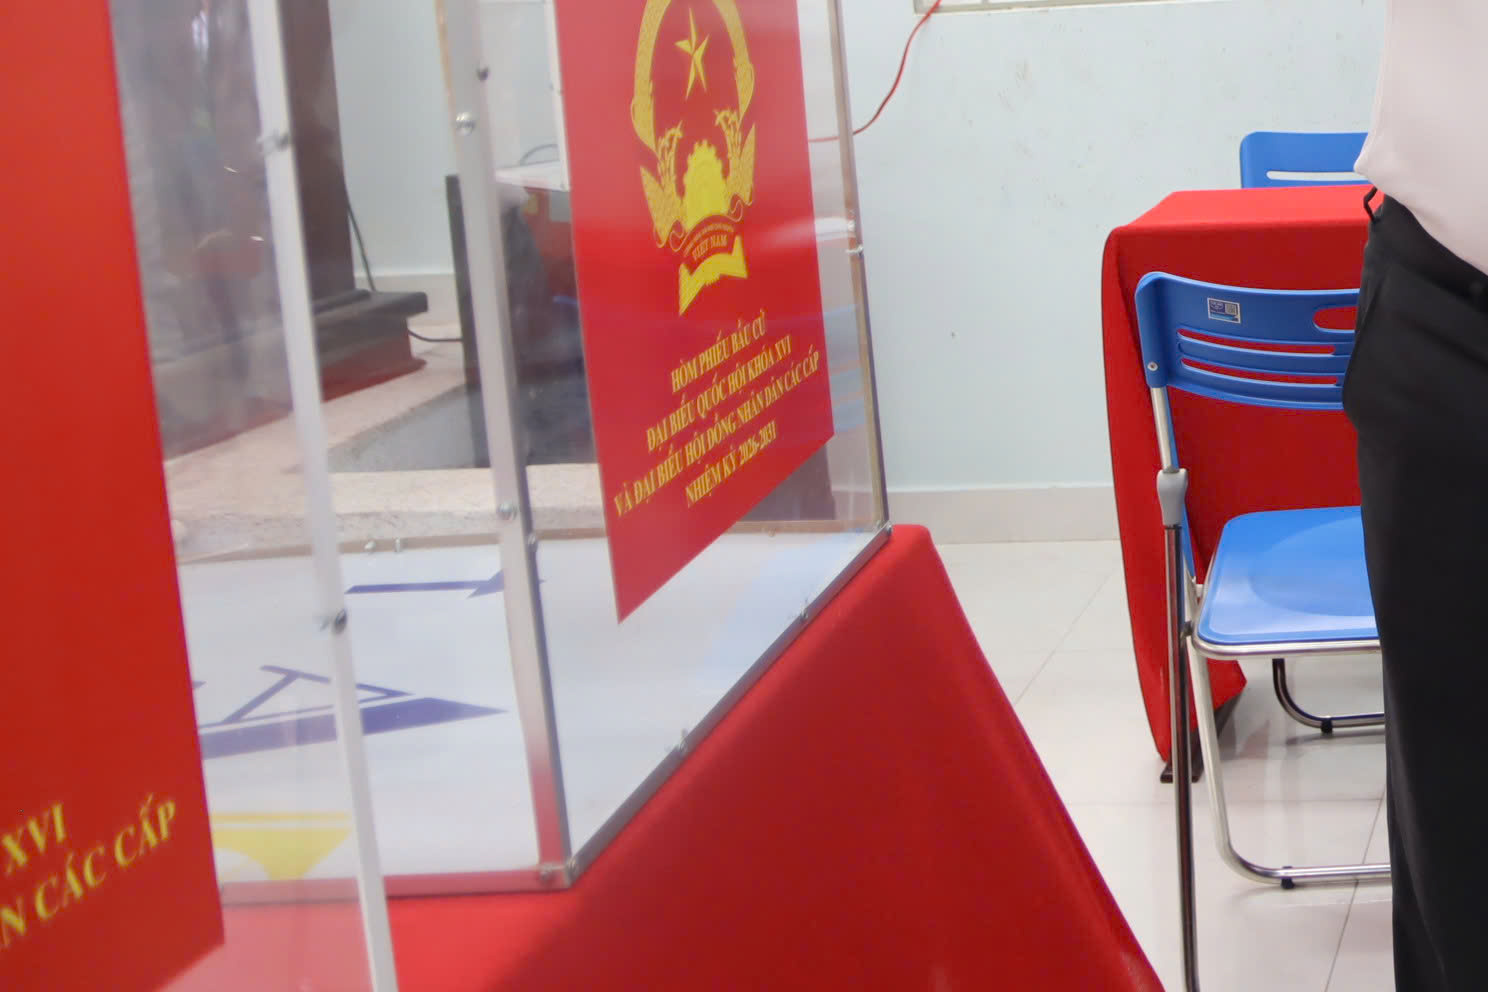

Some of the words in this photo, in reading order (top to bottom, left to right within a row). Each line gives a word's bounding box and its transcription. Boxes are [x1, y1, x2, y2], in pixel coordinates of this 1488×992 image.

[646, 417, 669, 452] ĐẠI
[669, 394, 696, 438] BIỂU
[696, 372, 727, 420] QUỐC
[728, 362, 748, 396] HỘI
[747, 344, 775, 382] KHÓA
[775, 334, 792, 362] XVI
[671, 359, 700, 393] HÒM
[699, 330, 731, 374] PHIẾU
[731, 318, 752, 354] BẦU
[614, 481, 633, 518] VÀ
[633, 469, 657, 505] ĐẠI
[657, 443, 684, 488] BIỂU
[684, 431, 705, 466] HỘI
[705, 412, 737, 451] ĐỒNG
[737, 390, 764, 425] NHÂN
[764, 376, 785, 409] DÂN
[784, 362, 802, 392] CÁC
[802, 343, 820, 378] CẤP
[685, 463, 723, 508] NHIỆM
[722, 445, 739, 480] KỲ
[739, 419, 778, 467] 2026-2031
[1, 802, 67, 877] XVI
[34, 844, 108, 920] CÁC
[114, 792, 176, 868] CẤP
